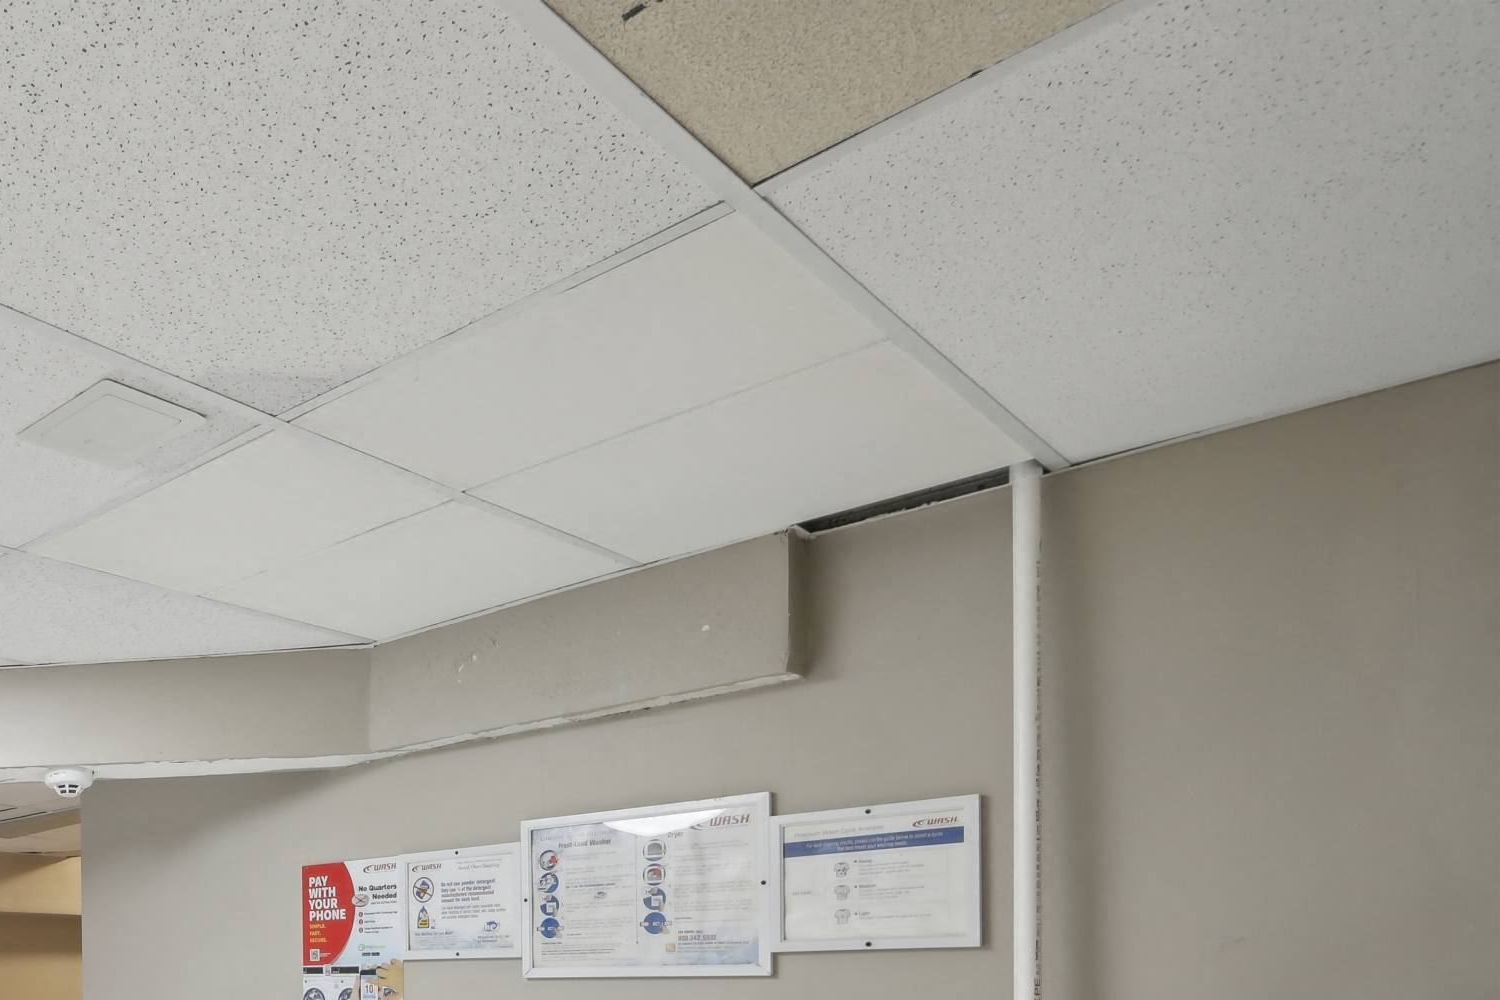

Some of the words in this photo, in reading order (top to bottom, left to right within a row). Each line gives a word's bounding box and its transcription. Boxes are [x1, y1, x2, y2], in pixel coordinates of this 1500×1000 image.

[709, 814, 750, 826] WASH
[927, 816, 958, 825] WASH
[373, 862, 397, 872] WASH
[421, 863, 442, 871] WASH
[308, 875, 329, 888] PAY
[308, 886, 337, 899] WITH
[369, 883, 397, 892] Quarters
[308, 898, 338, 910] YOUR
[309, 909, 347, 922] PHONE
[365, 984, 374, 994] 10
